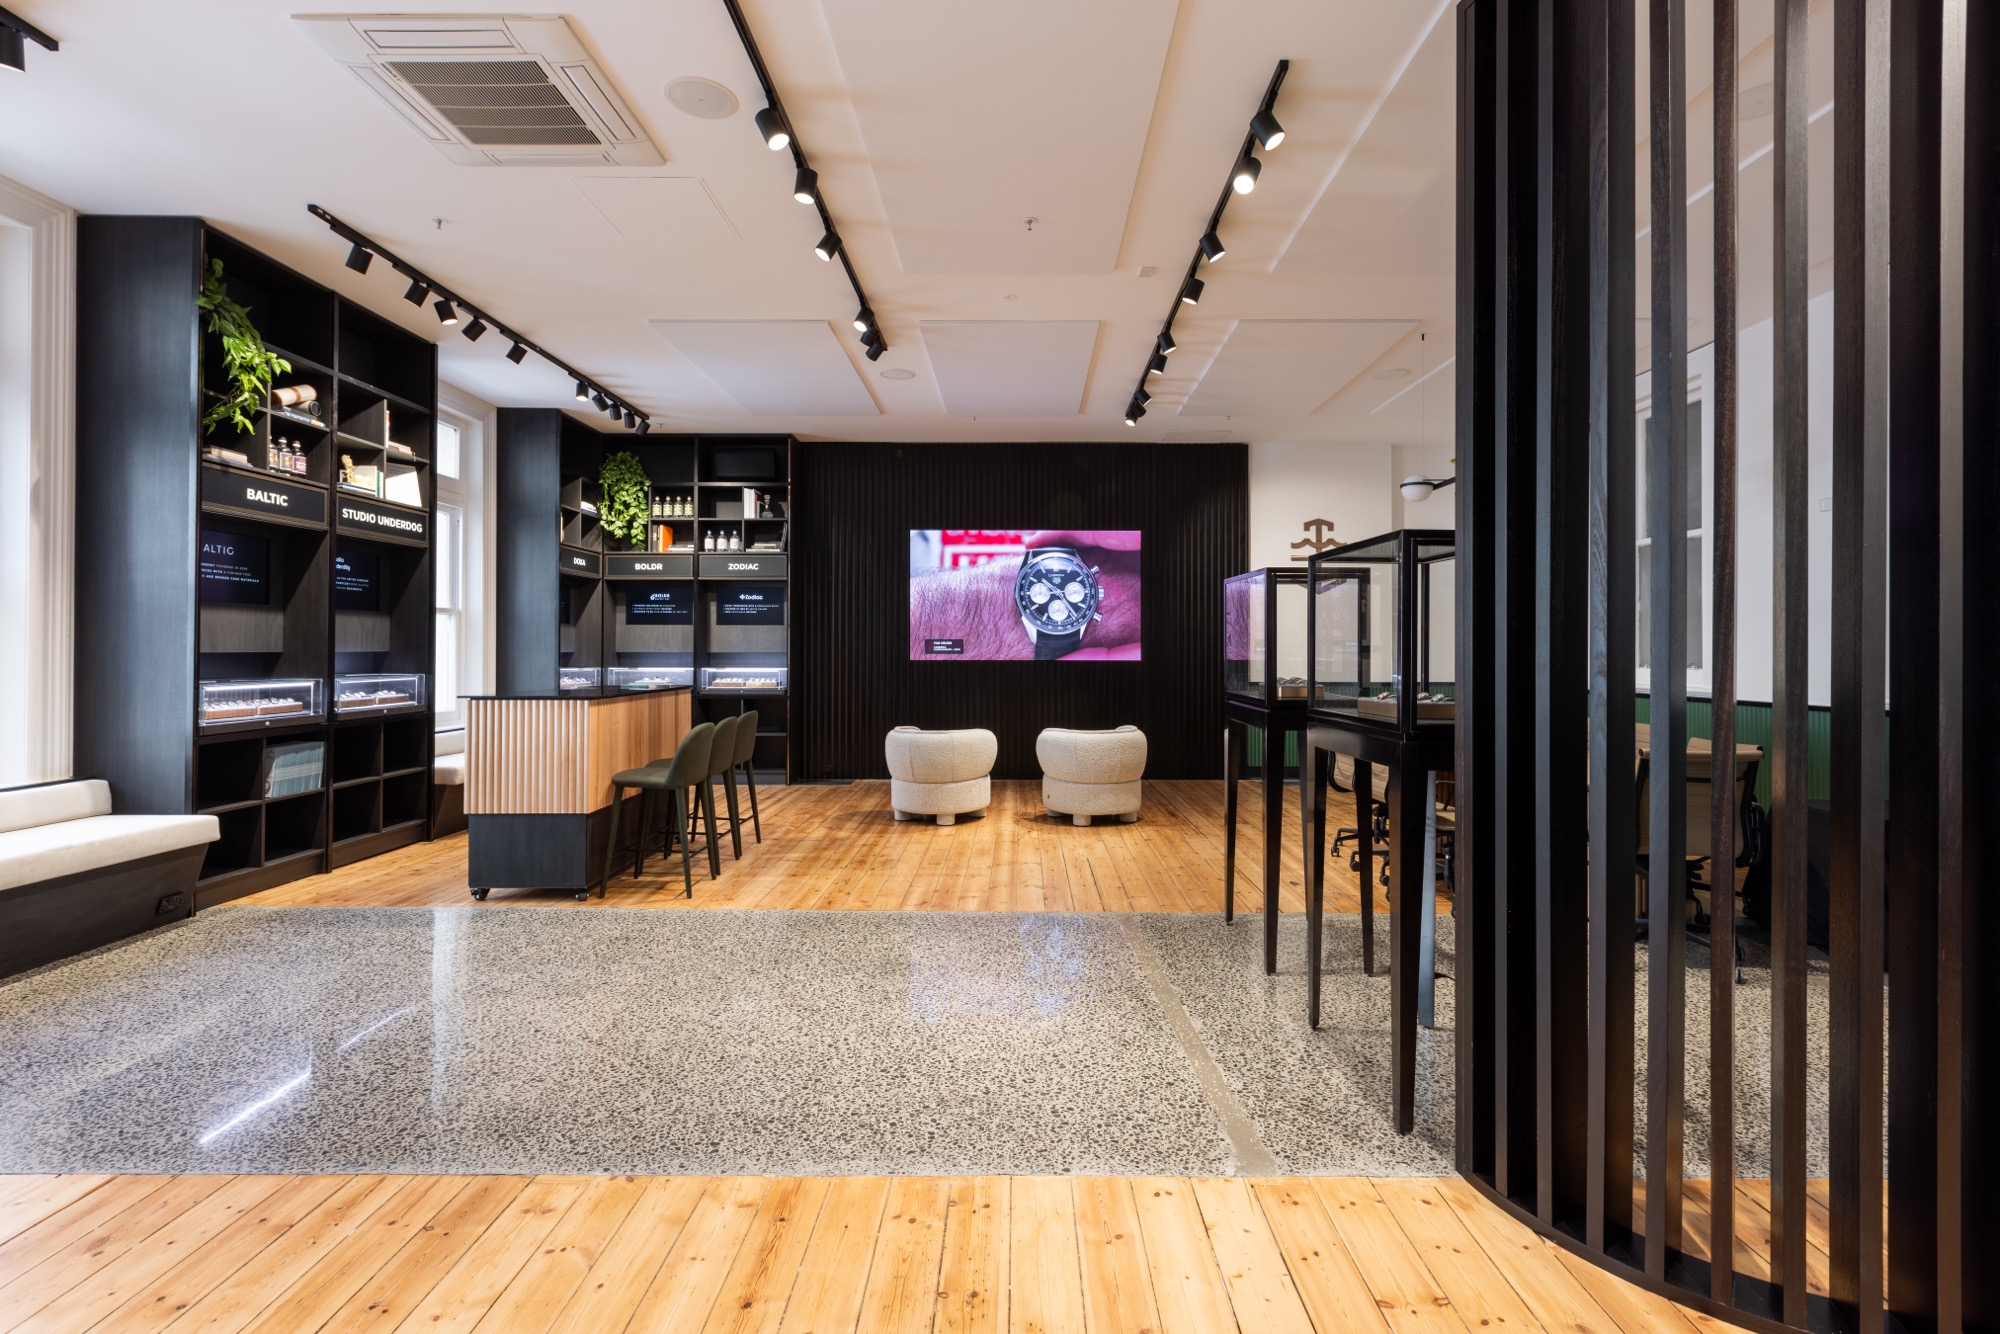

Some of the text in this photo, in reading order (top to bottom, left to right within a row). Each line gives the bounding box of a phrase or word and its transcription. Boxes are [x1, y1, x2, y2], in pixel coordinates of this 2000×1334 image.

[246, 488, 289, 506] BALTIC
[342, 508, 423, 533] STUDIO UNDERDOG
[203, 543, 234, 555] ALTIC
[573, 557, 586, 566] DOXA
